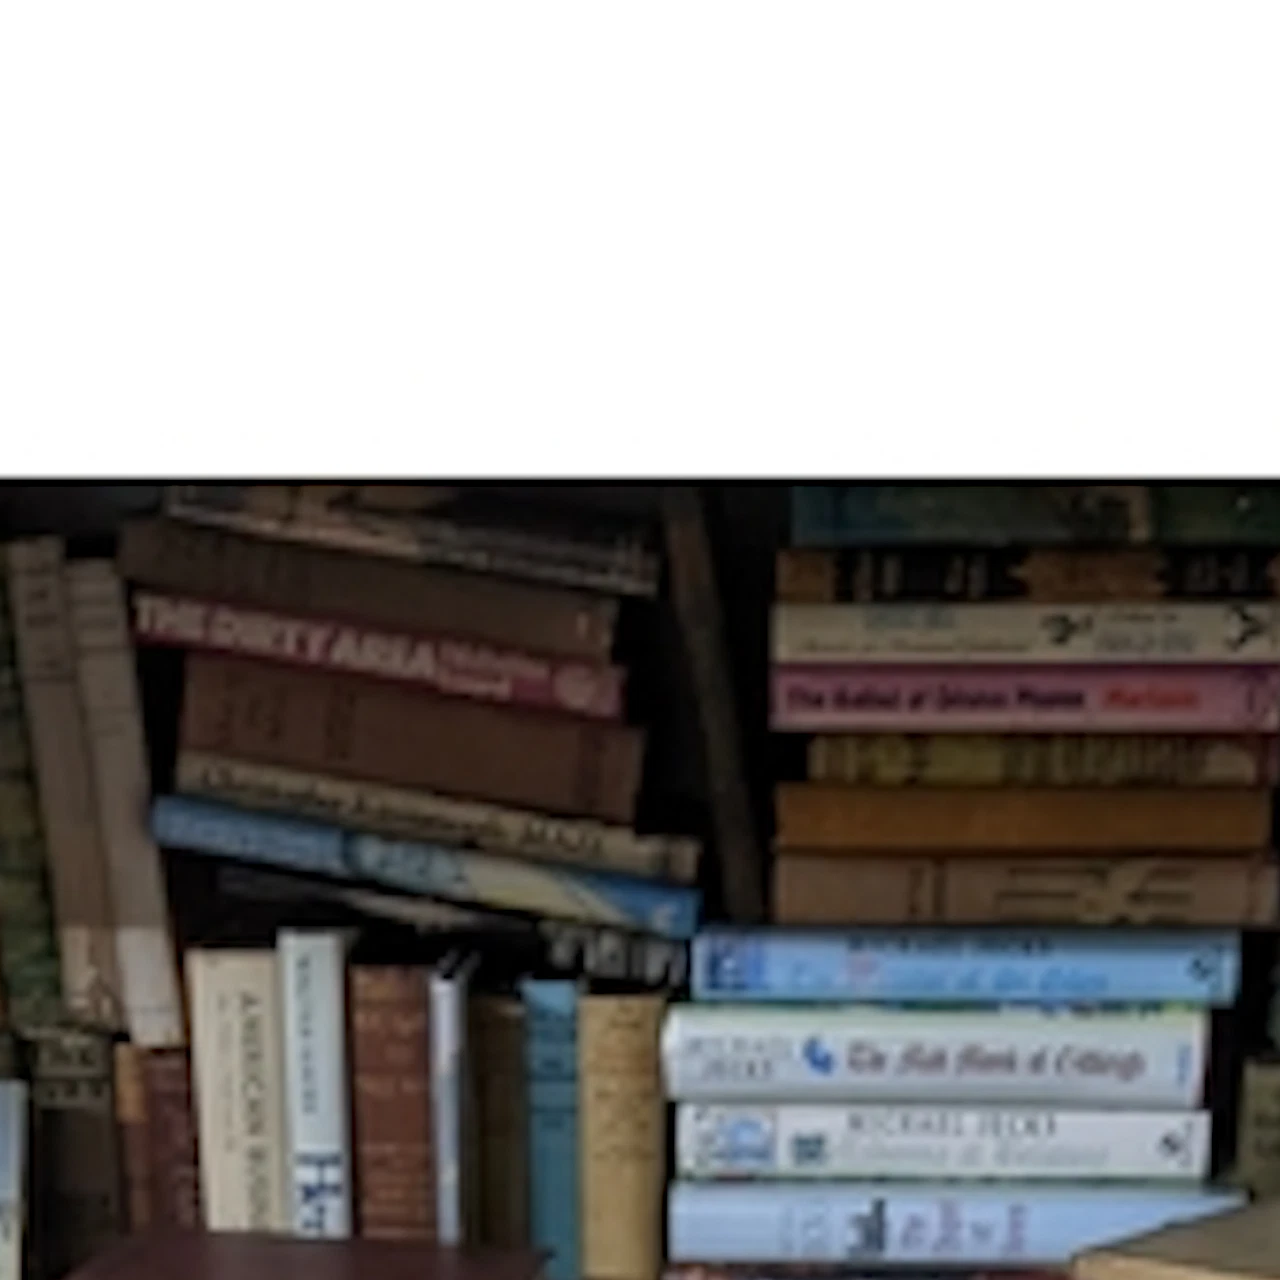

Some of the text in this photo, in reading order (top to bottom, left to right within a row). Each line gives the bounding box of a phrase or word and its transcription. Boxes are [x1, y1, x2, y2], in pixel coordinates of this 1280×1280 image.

[133, 592, 206, 640] THE
[208, 604, 332, 662] DIRTY
[847, 1041, 887, 1072] The
